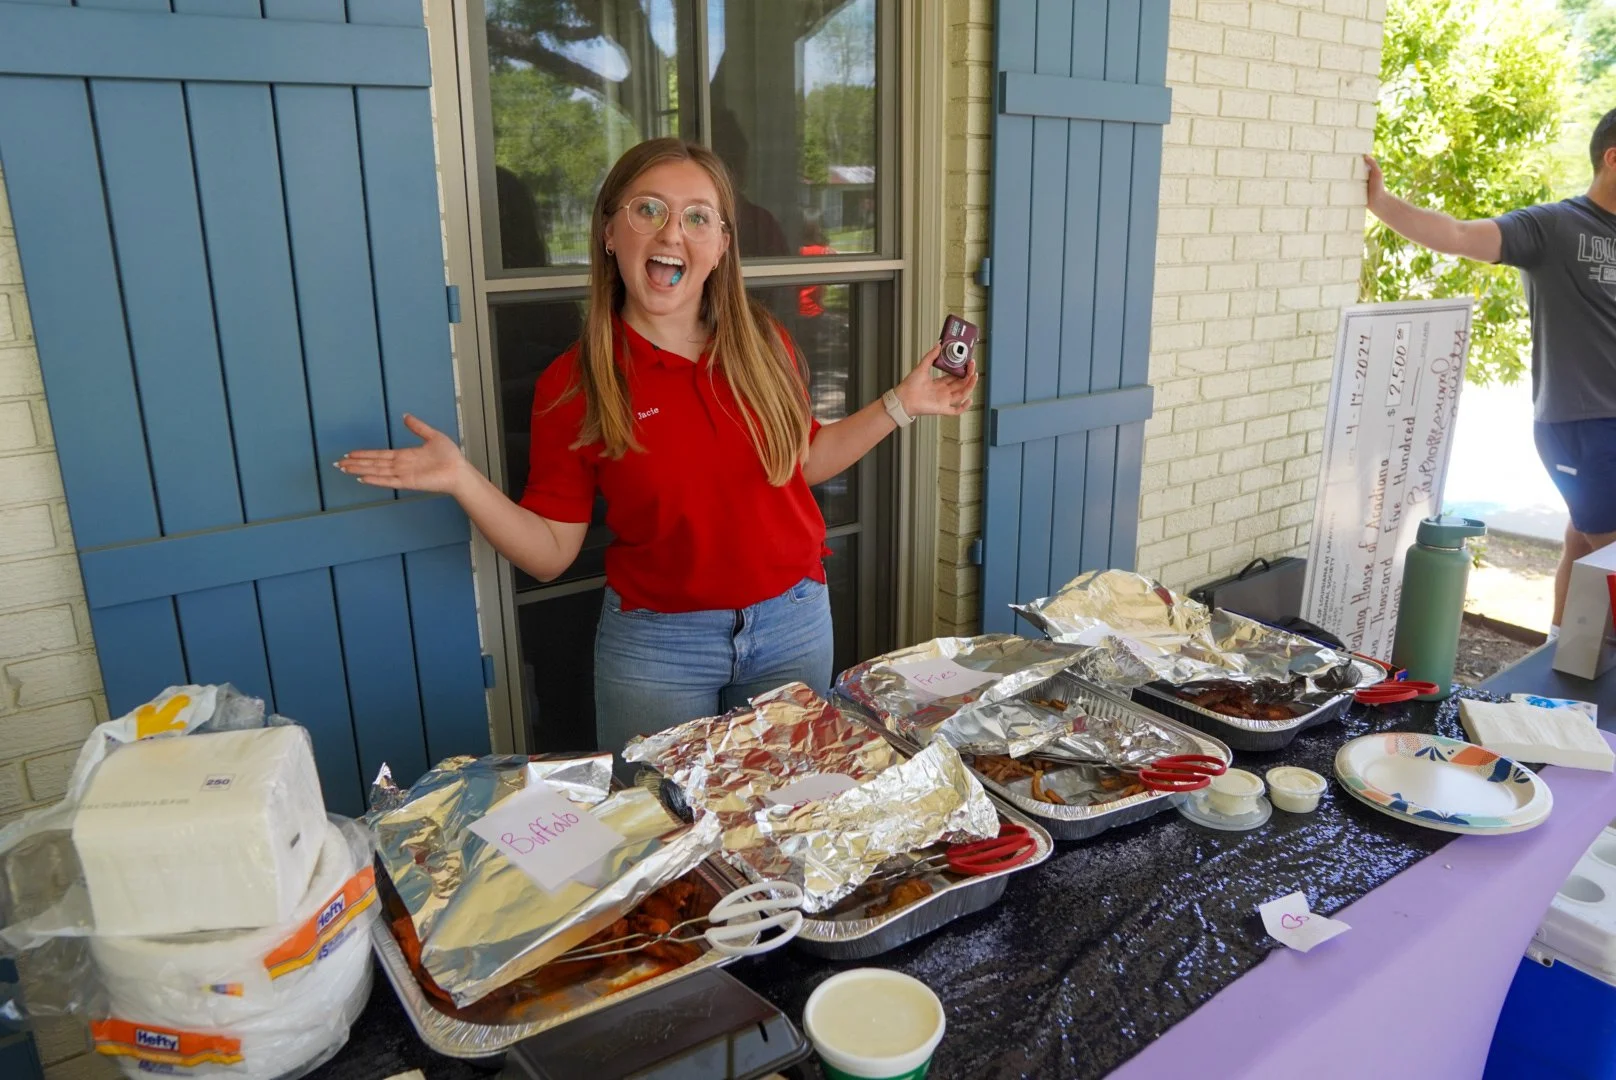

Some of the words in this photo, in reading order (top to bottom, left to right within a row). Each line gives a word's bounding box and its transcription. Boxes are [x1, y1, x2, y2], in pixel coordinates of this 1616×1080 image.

[637, 407, 660, 420] Jacie
[1366, 459, 1389, 530] Acadiana
[1371, 558, 1393, 629] Thousand
[1385, 503, 1401, 533] Five
[1394, 417, 1416, 485] Hundred
[1359, 541, 1377, 556] of
[1319, 566, 1328, 606] LOUISIANA
[1351, 562, 1374, 606] House
[913, 670, 957, 687] Fries
[501, 812, 579, 854] Buffalo
[138, 1030, 177, 1050] Hefty
